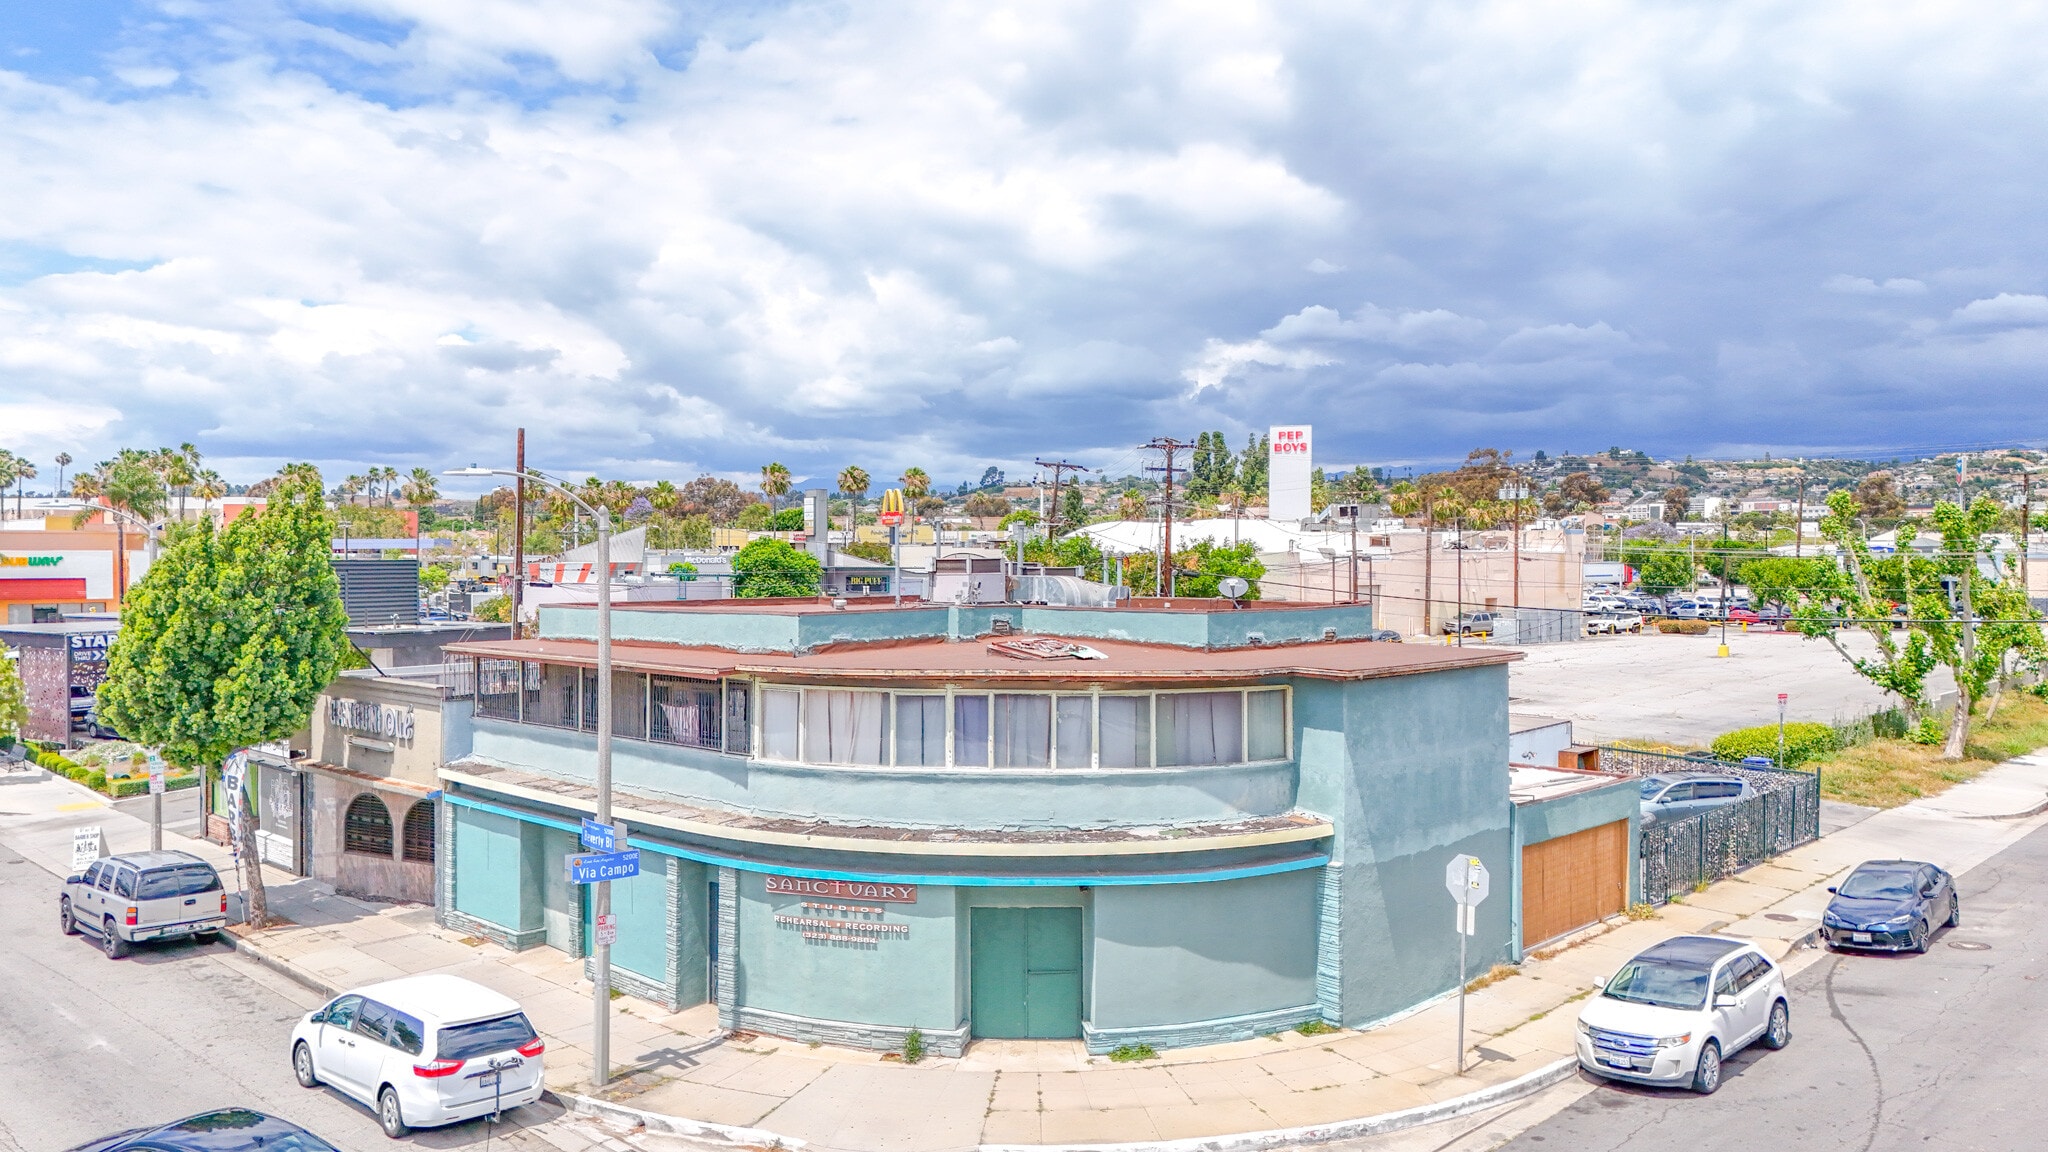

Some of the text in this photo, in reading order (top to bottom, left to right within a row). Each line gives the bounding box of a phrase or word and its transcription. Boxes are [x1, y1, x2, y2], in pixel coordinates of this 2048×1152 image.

[1278, 431, 1303, 441] PEP
[1274, 442, 1308, 453] BOYS
[685, 556, 727, 564] McDonald's
[584, 830, 604, 848] Beverly
[622, 853, 639, 861] 5200E
[579, 863, 634, 879] Via Campo
[766, 877, 915, 899] SANCTUARY
[800, 902, 883, 914] STUDIOS
[774, 915, 908, 933] REHEARSAL RECORDING
[802, 932, 827, 940] (323)
